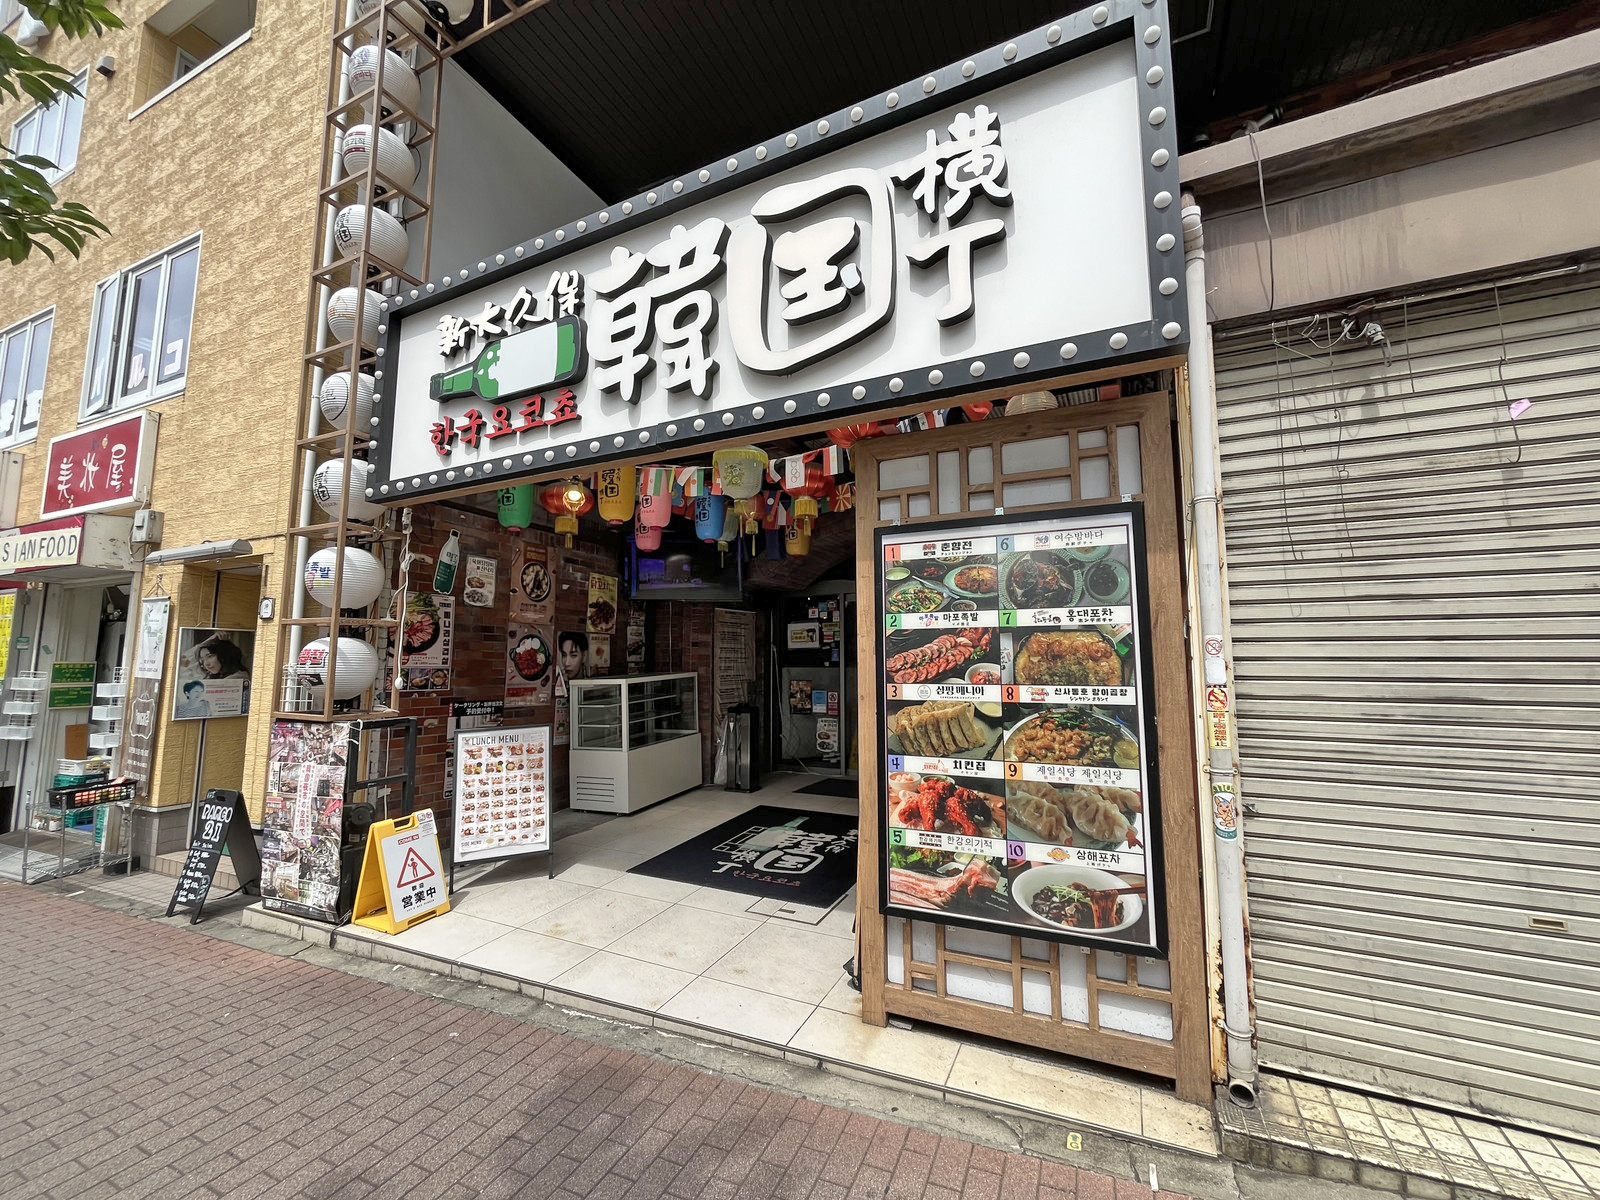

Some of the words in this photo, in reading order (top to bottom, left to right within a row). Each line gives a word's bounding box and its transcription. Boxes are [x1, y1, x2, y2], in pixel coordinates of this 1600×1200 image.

[901, 104, 1013, 327] 横丁
[587, 168, 898, 403] 韓国
[437, 271, 584, 356] 新大久保
[428, 389, 582, 456] 한국요코쵸
[1054, 530, 1105, 543] 여수밤바다
[1000, 538, 1009, 551] 6
[891, 547, 895, 559] 1
[890, 614, 897, 627] 2
[943, 612, 978, 622] 마포족발
[1002, 613, 1011, 625] 7
[1066, 608, 1114, 622] 홍대포차
[891, 685, 897, 697] 3
[1006, 687, 1014, 700] 8
[471, 736, 496, 746] LUNCH
[498, 734, 519, 744] MENU
[892, 757, 900, 769] 4
[953, 760, 986, 771] 치킨집
[1008, 763, 1017, 777] 9
[1037, 766, 1076, 777] 제일식당
[1081, 769, 1123, 781] 제일식당
[202, 820, 223, 842] 21
[893, 830, 902, 843] 5
[947, 835, 993, 850] 한강의기적
[1009, 844, 1023, 857] 10
[1076, 850, 1121, 864] 상해포차
[401, 886, 437, 909] 営業中
